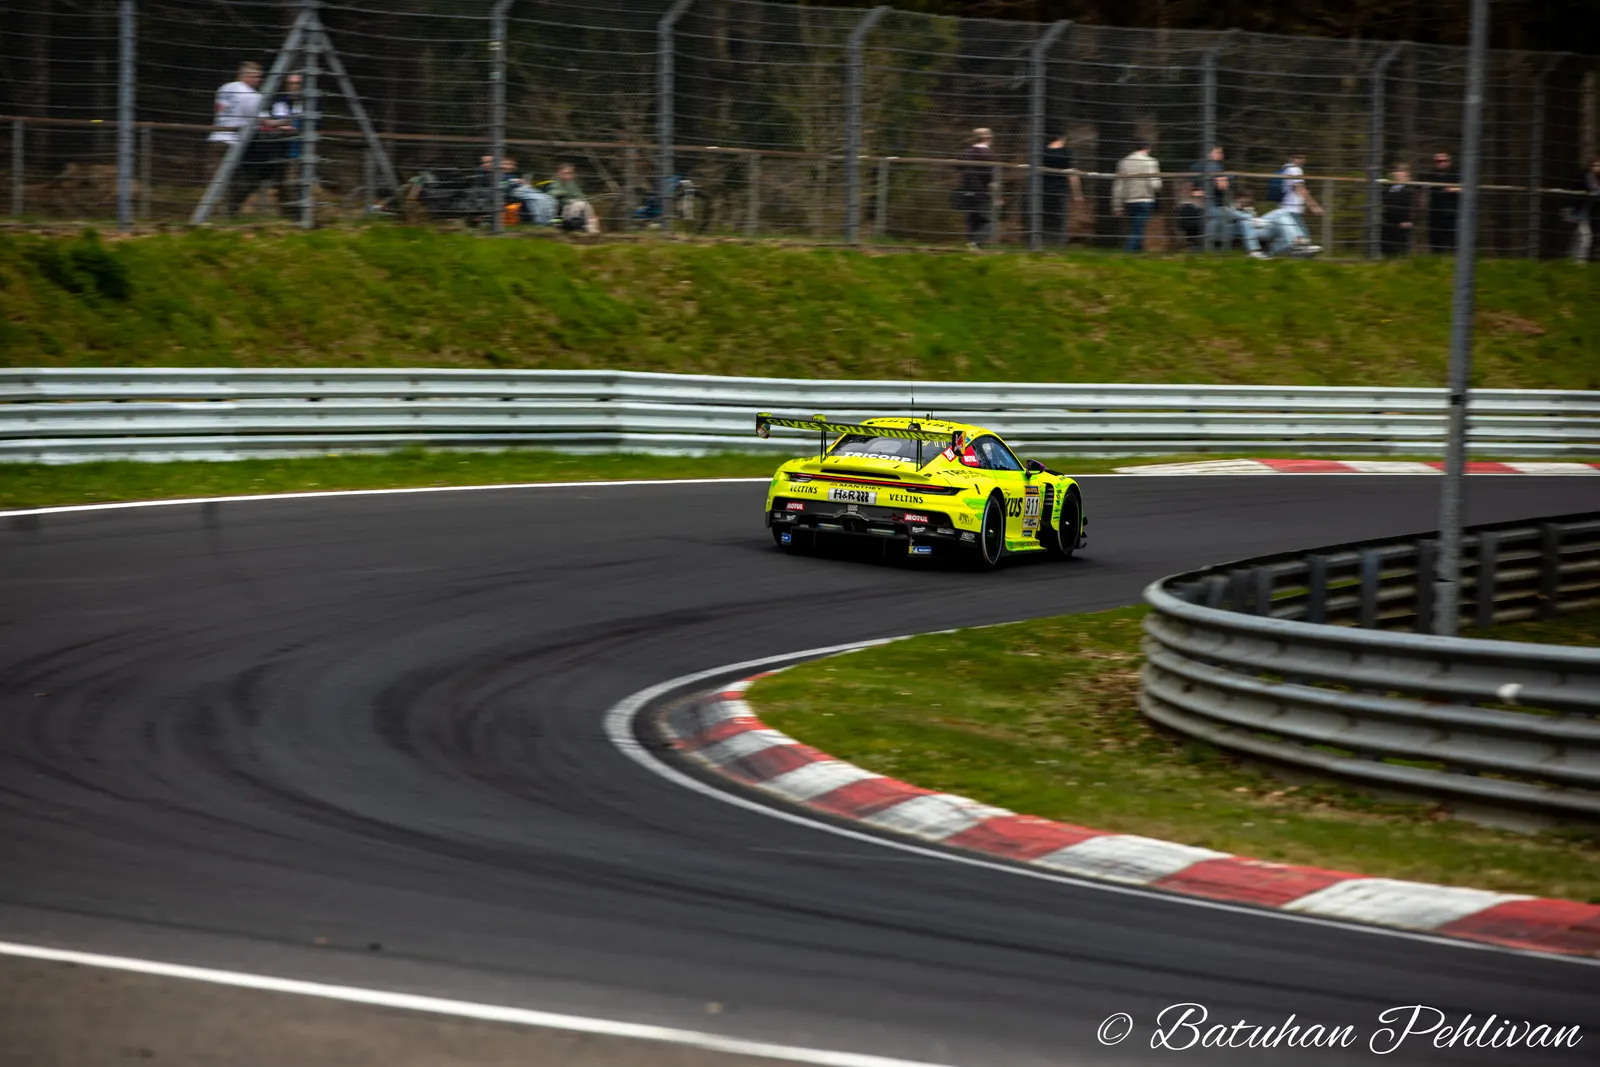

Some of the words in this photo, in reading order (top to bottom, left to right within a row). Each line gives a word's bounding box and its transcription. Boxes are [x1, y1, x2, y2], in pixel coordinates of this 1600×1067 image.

[765, 418, 820, 431] GIVES
[822, 423, 867, 435] YOU
[844, 451, 912, 463] TRICORP
[789, 485, 818, 494] VELTINS
[889, 493, 924, 504] VELTINS
[1025, 497, 1039, 515] 911
[904, 514, 928, 522] MOTUL
